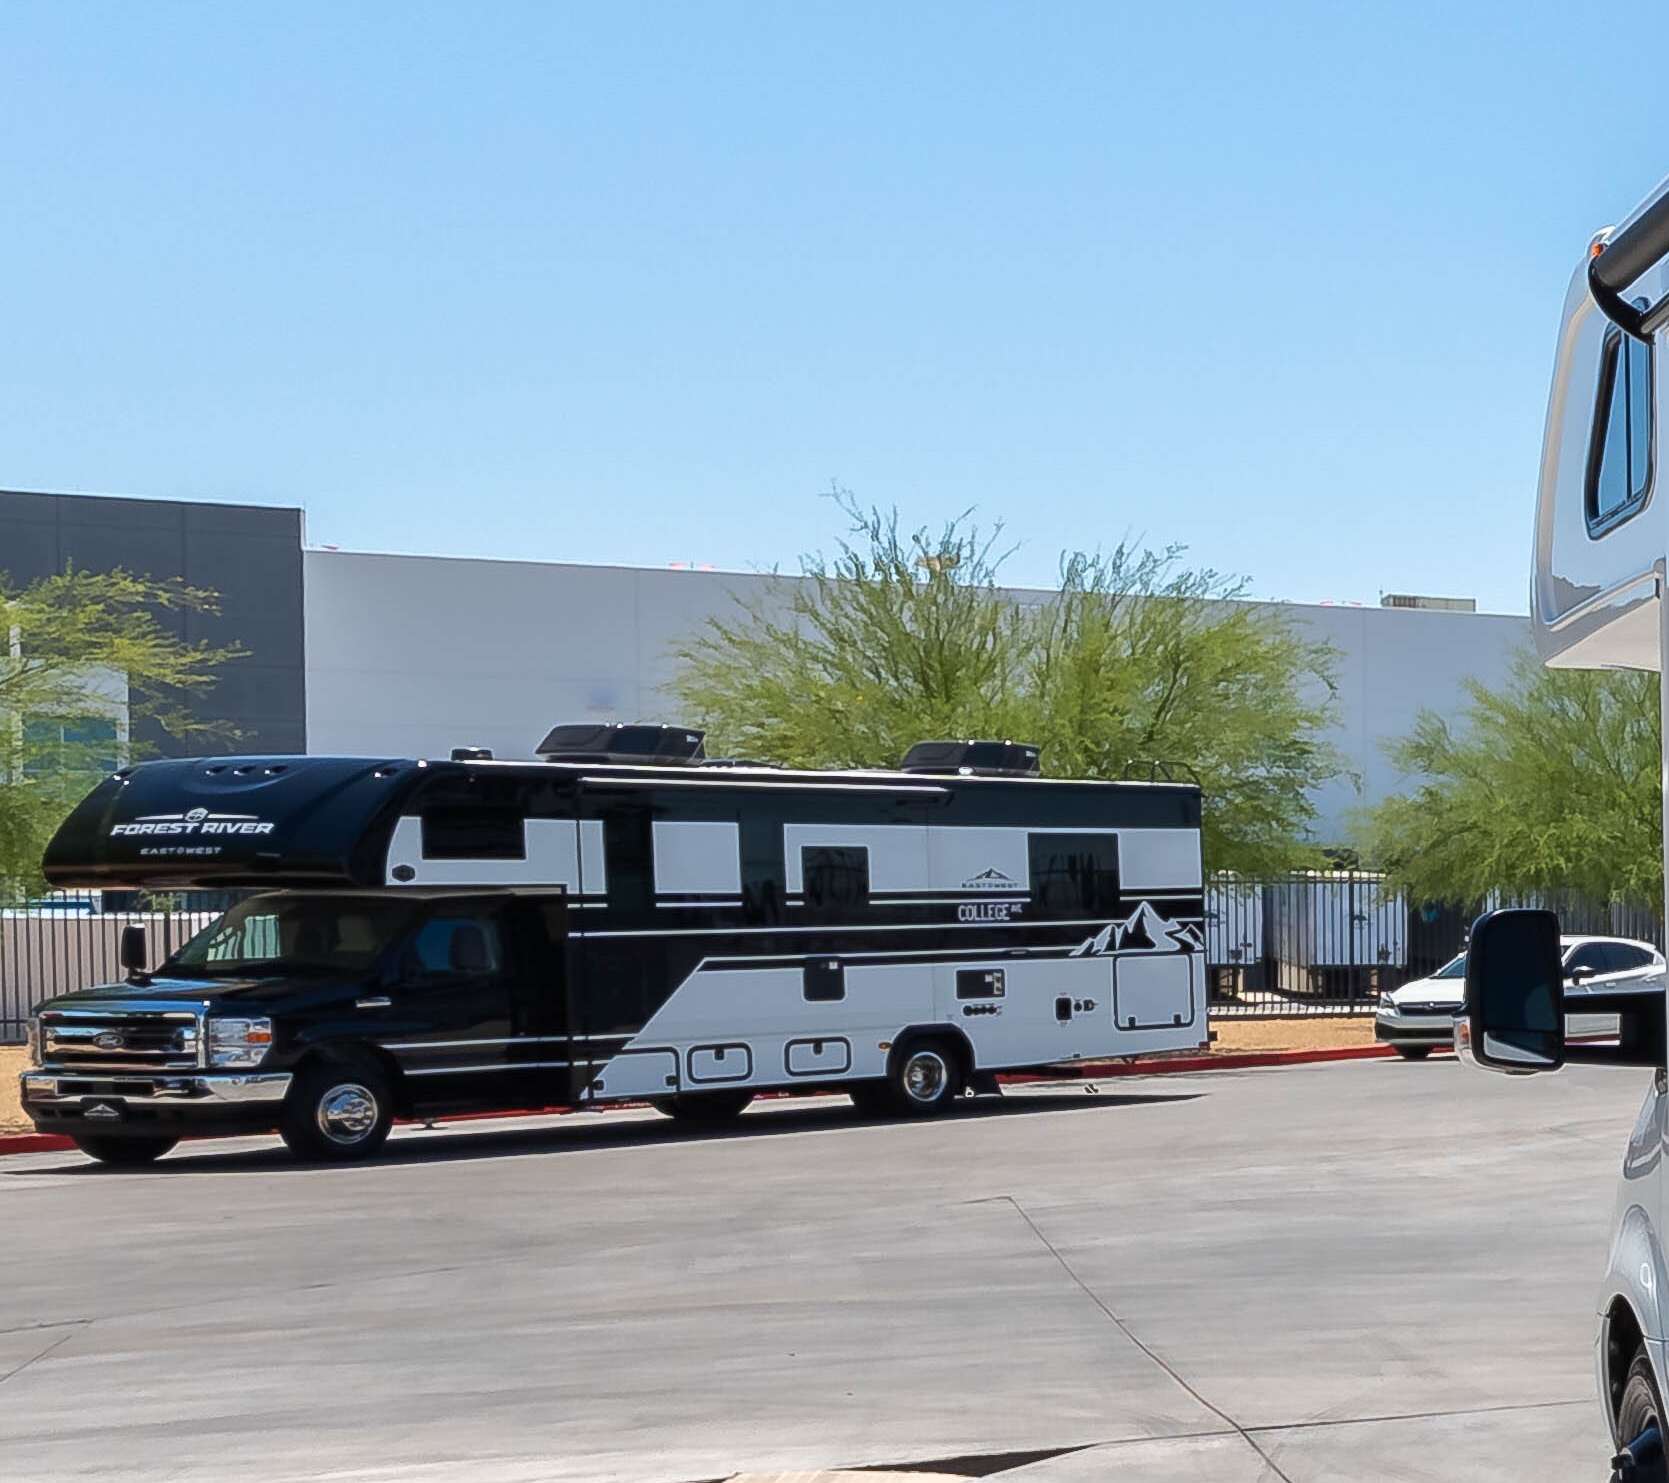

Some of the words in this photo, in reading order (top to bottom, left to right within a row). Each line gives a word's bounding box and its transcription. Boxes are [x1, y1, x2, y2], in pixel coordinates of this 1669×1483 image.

[110, 822, 199, 836] FOREST
[200, 822, 275, 834] RIVER
[958, 904, 1010, 921] COLLEGE
